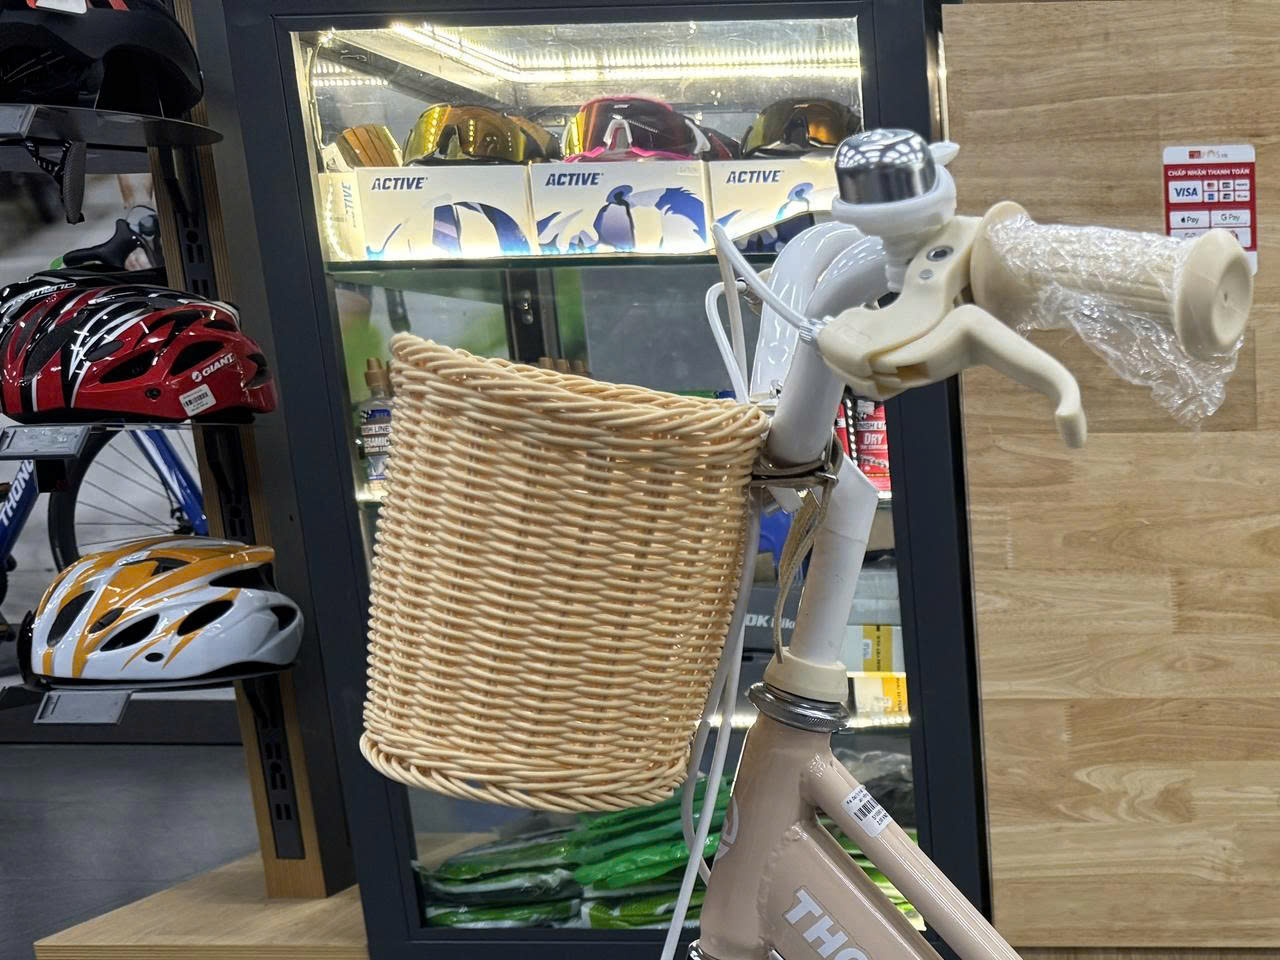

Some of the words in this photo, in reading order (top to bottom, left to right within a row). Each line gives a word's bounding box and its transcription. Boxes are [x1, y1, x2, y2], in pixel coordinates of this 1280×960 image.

[371, 176, 427, 191] ACTIVE
[545, 172, 602, 187] ACTIVE
[726, 170, 782, 184] ACTIVE
[1174, 187, 1198, 198] VISA
[1187, 216, 1199, 225] Pay
[1229, 213, 1241, 223] Pay
[202, 352, 235, 377] GIANT
[864, 432, 885, 445] DRY
